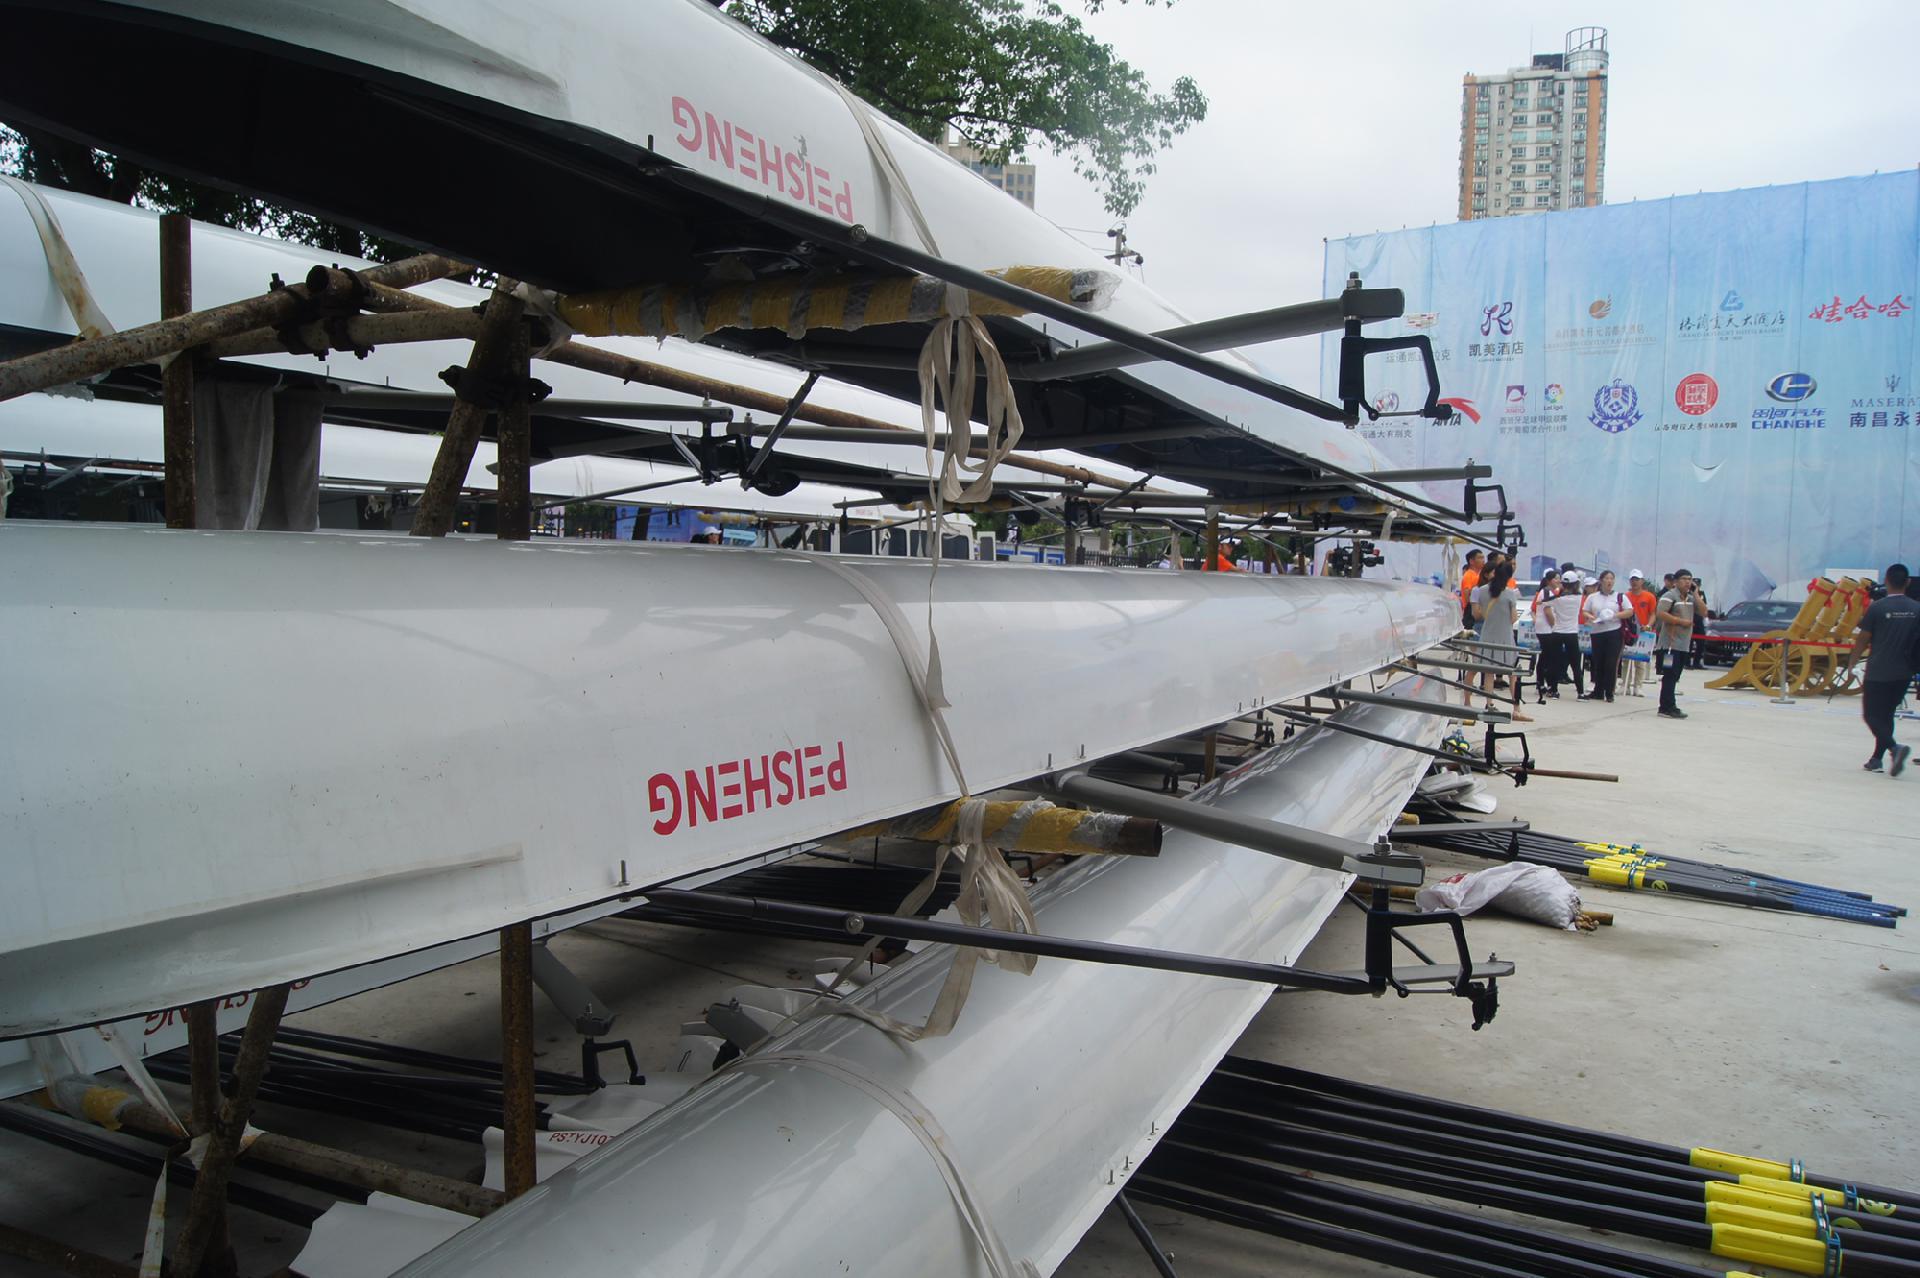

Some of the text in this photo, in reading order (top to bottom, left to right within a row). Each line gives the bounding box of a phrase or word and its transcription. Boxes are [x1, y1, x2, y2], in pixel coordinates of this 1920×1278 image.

[672, 96, 853, 224] PEISHENG
[1808, 293, 1912, 323] 娃哈哈
[1468, 341, 1524, 357] 凯美酒店
[1752, 418, 1826, 430] CHANGHE
[647, 740, 847, 836] PEISHENG
